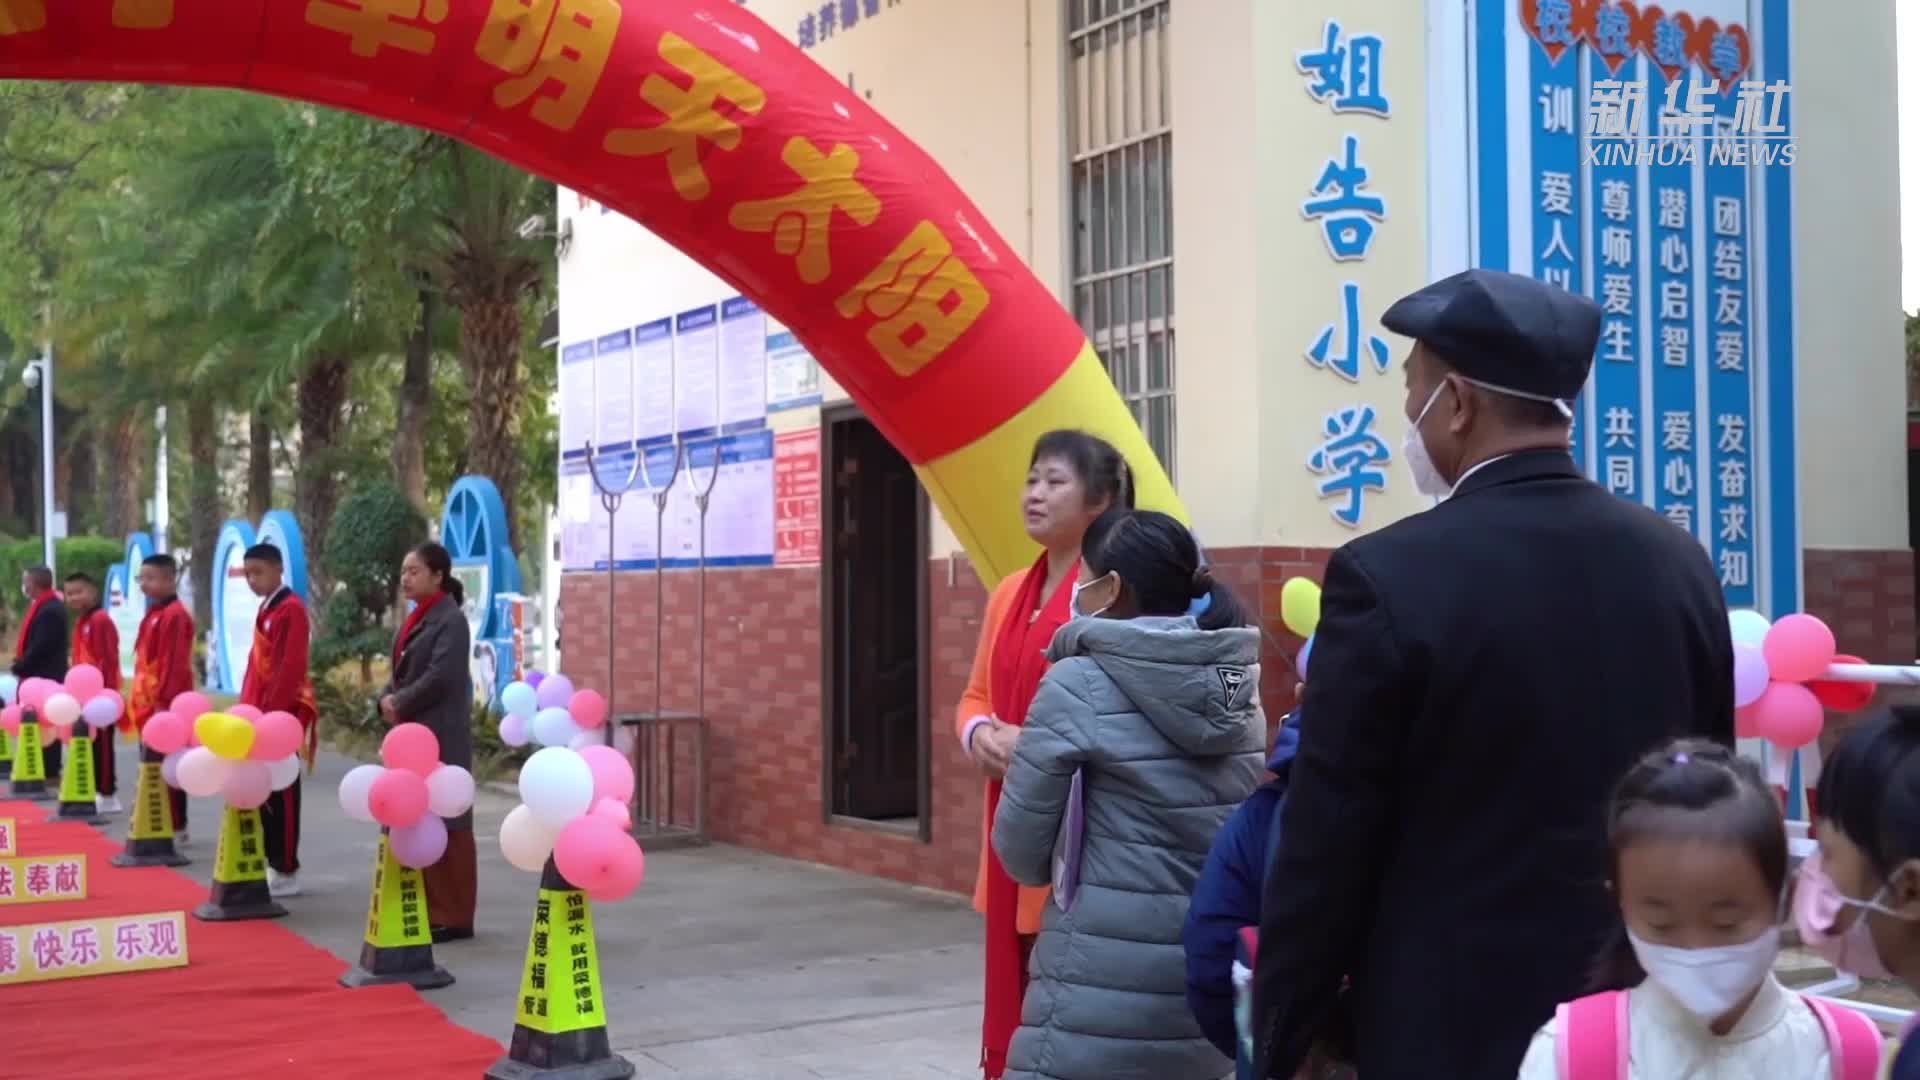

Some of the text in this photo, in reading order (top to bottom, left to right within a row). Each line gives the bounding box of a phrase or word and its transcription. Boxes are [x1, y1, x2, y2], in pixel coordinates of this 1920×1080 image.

[1296, 17, 1392, 528] 姐告小学
[1601, 180, 1634, 363] 尊师爱生
[1658, 187, 1690, 368] 潜心启智
[1712, 196, 1744, 372] 团结友爱
[1604, 406, 1635, 495] 共同
[1717, 413, 1748, 587] 发奋求知
[26, 861, 80, 895] 奉献
[33, 926, 99, 969] 快乐
[116, 919, 179, 961] 乐观
